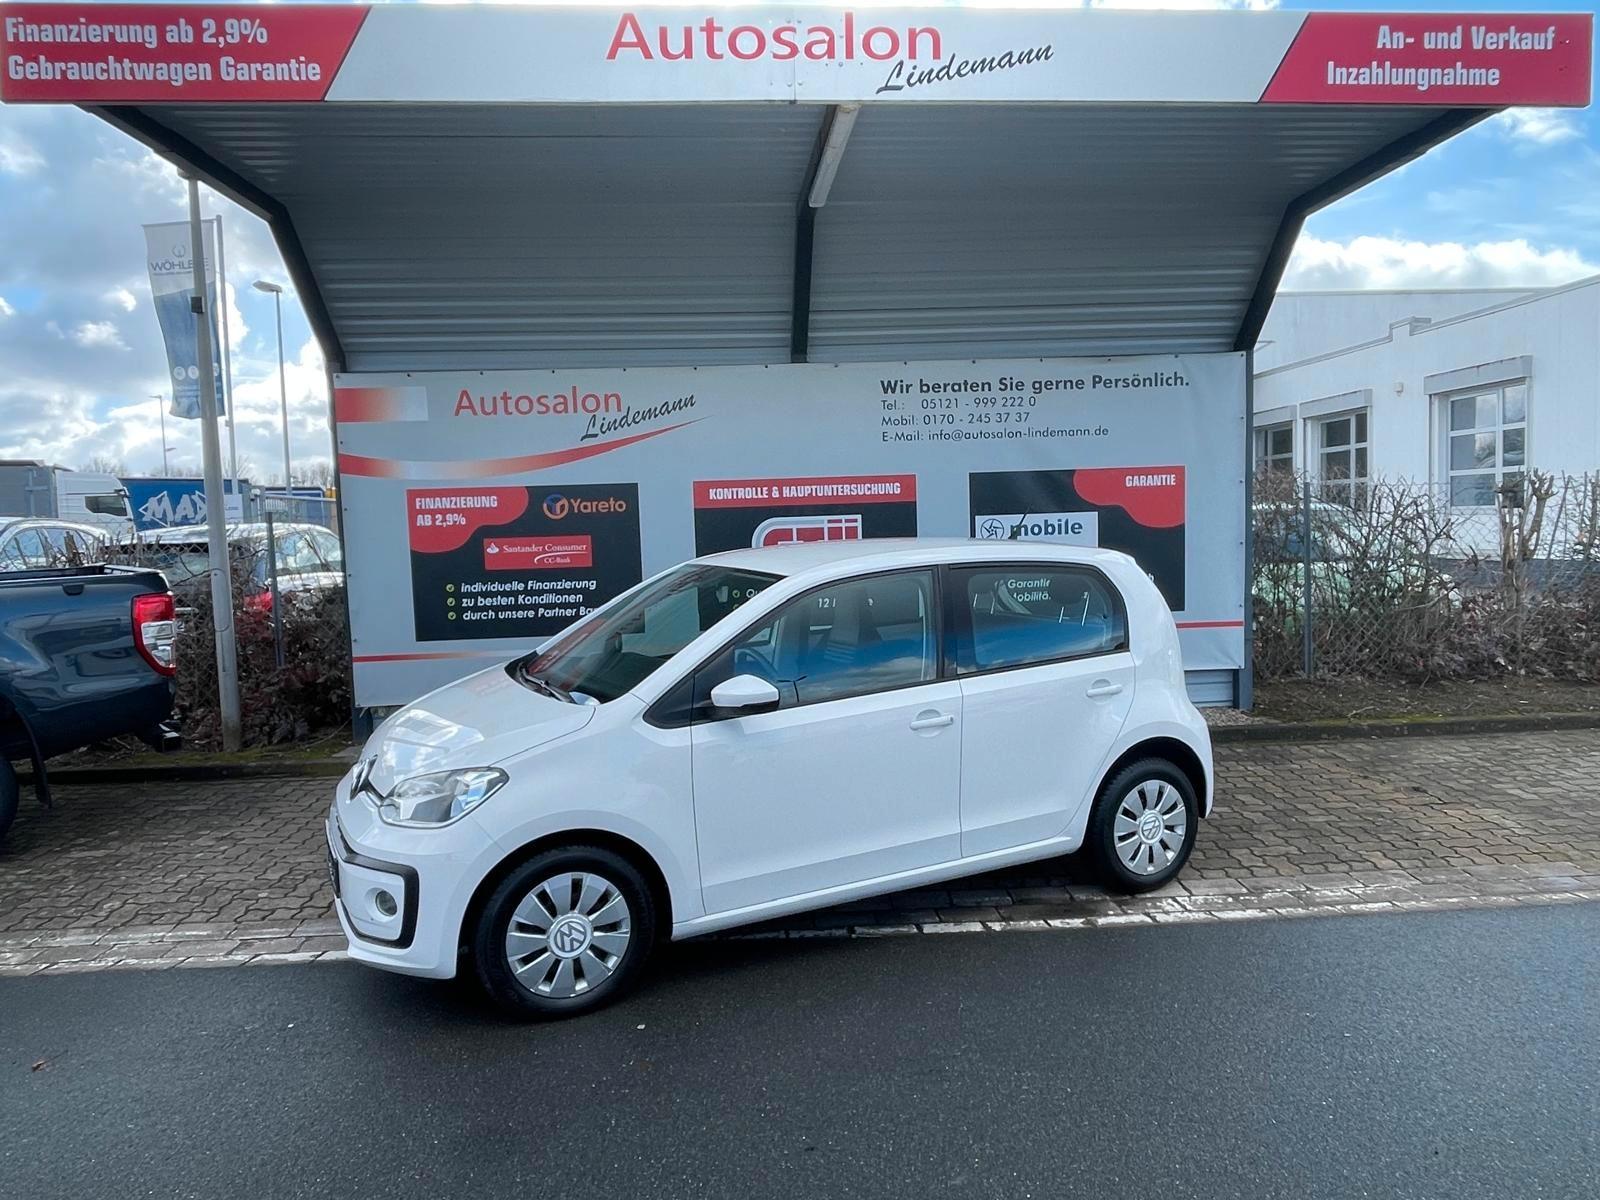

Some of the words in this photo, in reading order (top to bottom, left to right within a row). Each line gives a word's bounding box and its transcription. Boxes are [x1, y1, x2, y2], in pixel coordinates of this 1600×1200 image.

[5, 17, 157, 49] Finanzierung
[165, 18, 194, 43] ab
[202, 18, 268, 48] 2,9%
[606, 11, 943, 61] Autosalon
[1377, 25, 1415, 49] An-
[1423, 26, 1462, 50] und
[1471, 26, 1555, 50] Verkauf
[8, 55, 212, 86] Gebrauchtwagen
[219, 56, 321, 82] Garantie
[876, 43, 1055, 94] Lindemann
[1327, 61, 1500, 91] Inzahlungnahme
[880, 379, 912, 394] Wir
[920, 378, 992, 394] beraten
[998, 377, 1025, 391] Sie
[1032, 378, 1086, 395] gerne
[1092, 372, 1190, 390] Persönlich.
[454, 386, 623, 417] Autosalon
[881, 399, 905, 410] Tel.:
[921, 398, 959, 410] 05121
[974, 397, 997, 408] 999
[1002, 396, 1024, 407] 222
[1029, 396, 1036, 407] 0
[580, 393, 696, 442] Lindemann
[881, 414, 918, 426] Mobil:
[923, 414, 954, 425] 0170
[968, 413, 991, 424] 245
[995, 412, 1010, 423] 37
[1015, 412, 1030, 423] 37
[882, 430, 923, 442] E-Mail:
[928, 425, 1109, 442] info@autosalon-lindemann.de
[1125, 474, 1176, 487] GARANTIE
[709, 486, 768, 500] KONTROLLE
[772, 486, 779, 498] &
[783, 482, 901, 498] HAUPTUNTERSUCHUNG
[415, 495, 498, 510] FINANZIERUNG
[570, 497, 626, 514] Yareto
[416, 514, 431, 526] AB
[435, 513, 466, 527] 2,9%
[503, 543, 543, 553] Santander
[545, 543, 588, 552] Consumer
[461, 581, 525, 593] individuelle
[528, 579, 597, 590] Finanzierung
[462, 598, 474, 607] zu
[478, 595, 515, 606] besten
[518, 593, 583, 605] Konditionen
[463, 609, 495, 621] durch
[499, 610, 535, 619] unsere
[538, 607, 576, 618] Partner
[580, 606, 598, 617] Ba
